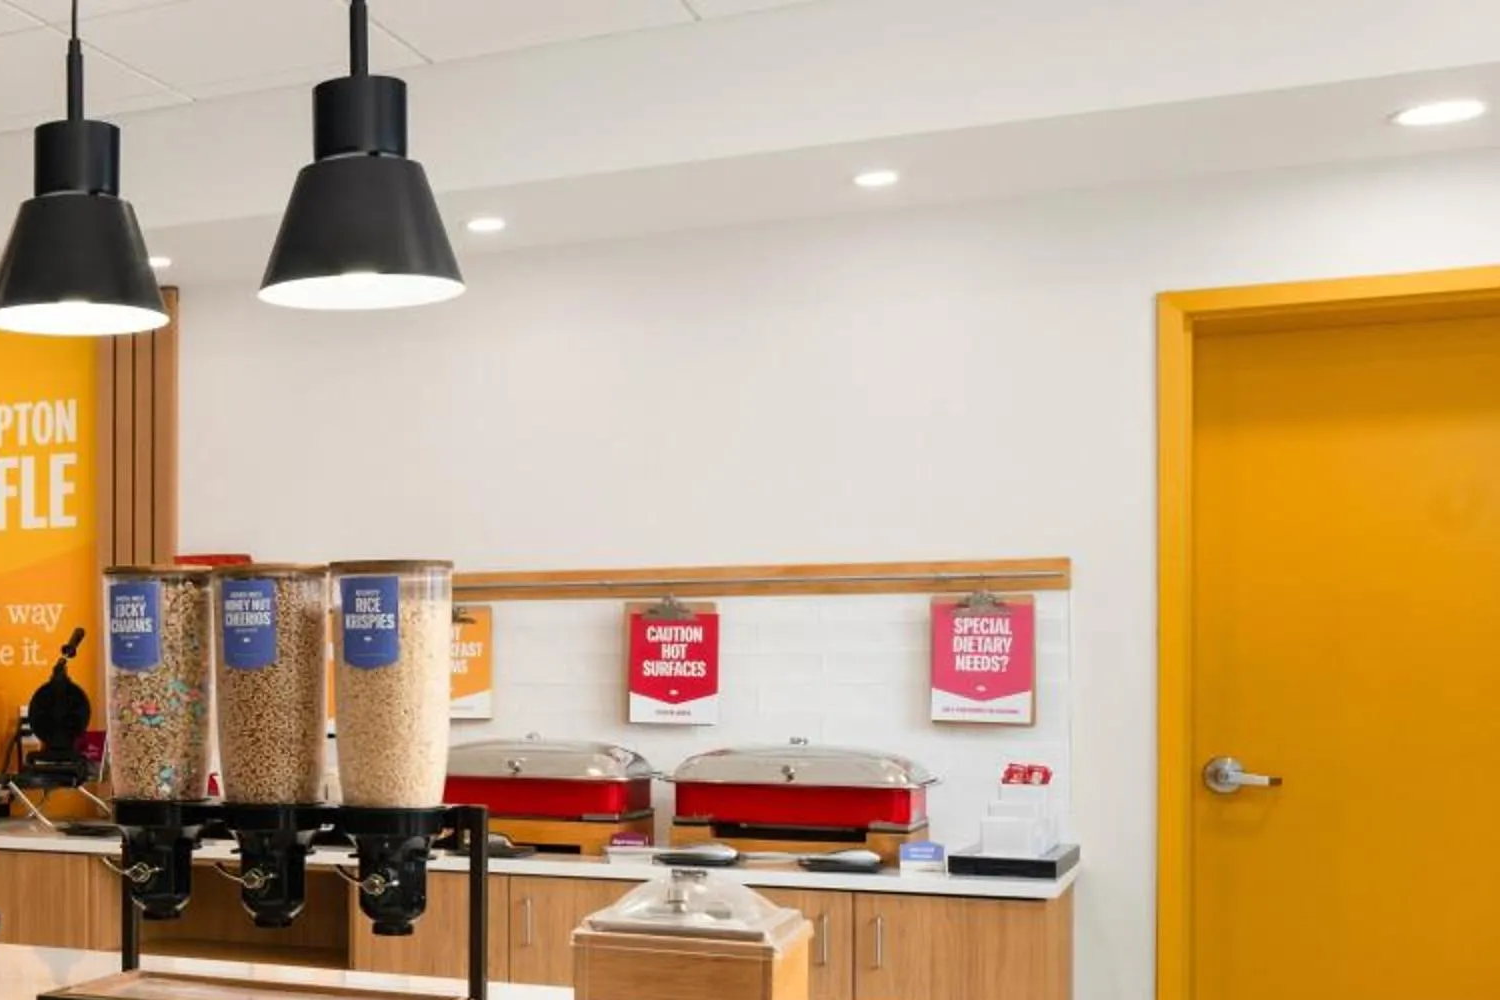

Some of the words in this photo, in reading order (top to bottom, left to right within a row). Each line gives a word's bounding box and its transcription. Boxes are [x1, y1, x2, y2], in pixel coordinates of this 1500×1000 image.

[355, 597, 382, 612] RICE
[6, 603, 64, 633] way
[345, 614, 395, 630] KRISPIES
[953, 617, 1012, 635] SPECIAL
[646, 625, 703, 642] CAUTION
[21, 637, 48, 666] it.
[661, 643, 688, 659] HOT
[953, 635, 1013, 653] DIETARY
[642, 660, 707, 677] SURFACES
[954, 655, 1009, 672] NEEDS?
